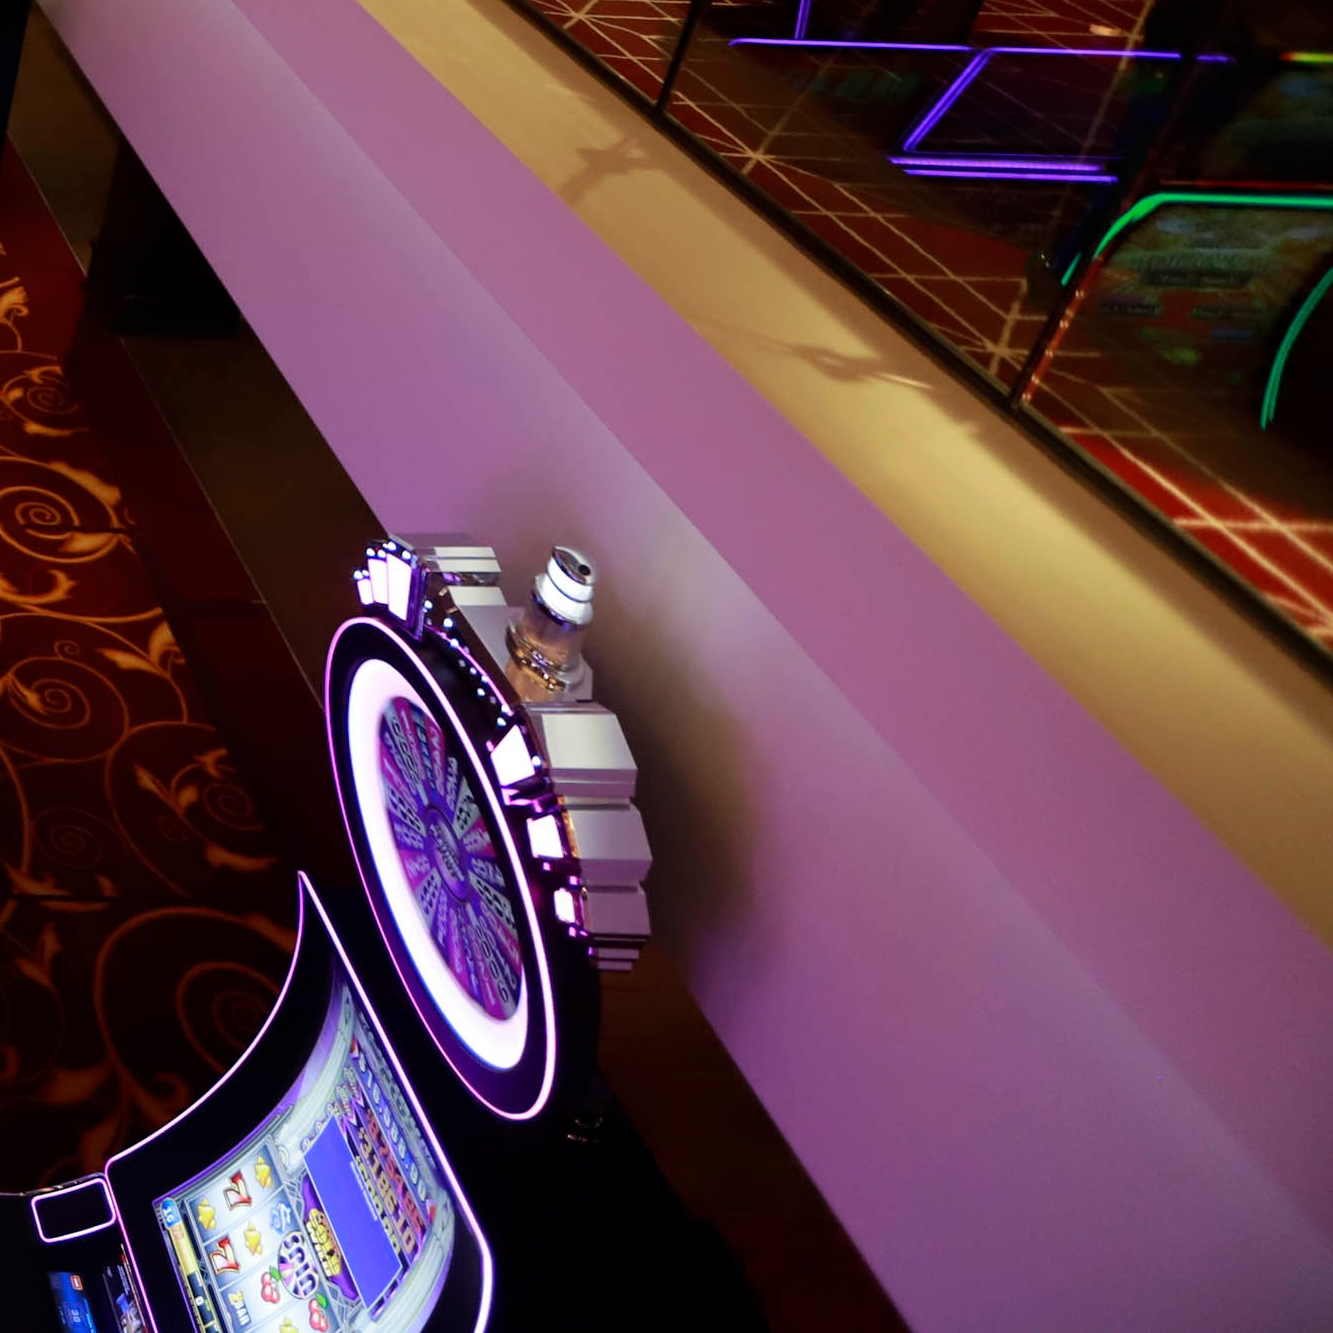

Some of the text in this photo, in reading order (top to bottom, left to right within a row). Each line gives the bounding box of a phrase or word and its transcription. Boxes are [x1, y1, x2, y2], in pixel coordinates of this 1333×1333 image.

[223, 1172, 252, 1210] 7
[210, 1236, 240, 1274] 7
[284, 1234, 316, 1298] SPIN
